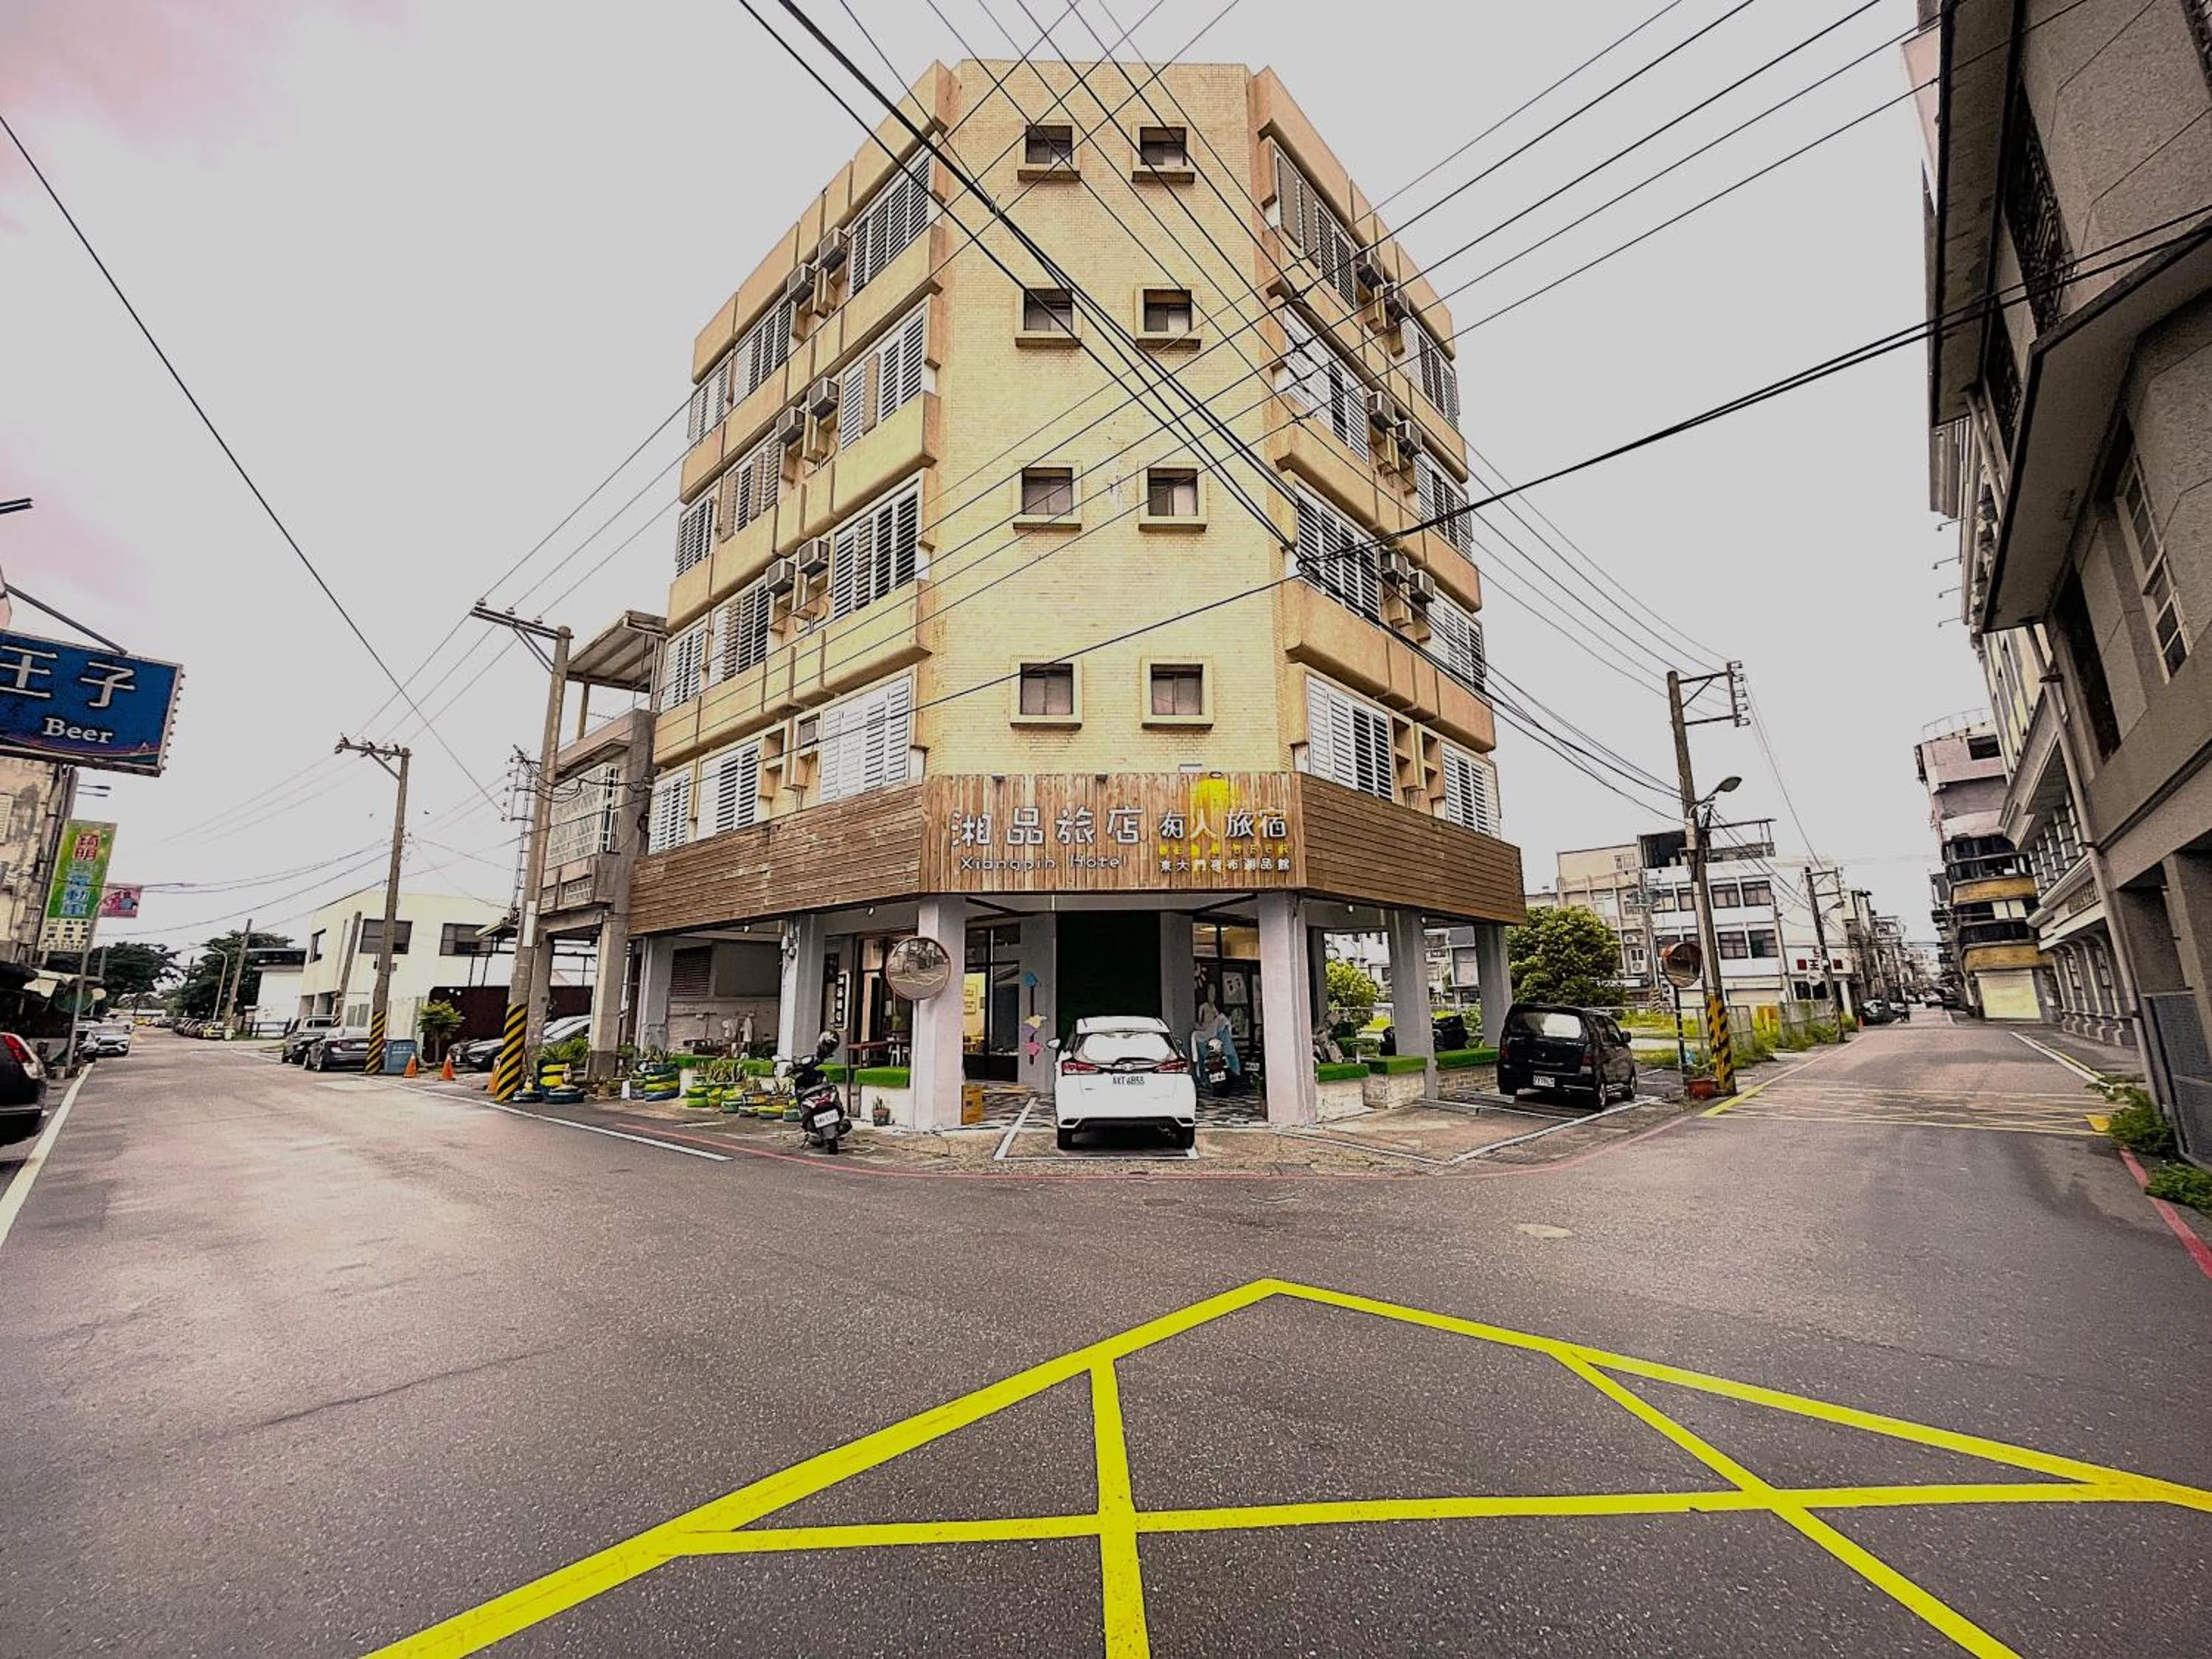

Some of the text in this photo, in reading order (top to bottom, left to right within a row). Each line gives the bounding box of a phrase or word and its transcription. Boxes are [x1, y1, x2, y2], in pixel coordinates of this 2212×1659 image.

[0, 645, 136, 707] 王子
[42, 717, 114, 745] Beer
[950, 805, 1144, 847] 湘品旅店
[961, 852, 1128, 871] Xiangpin Hotel
